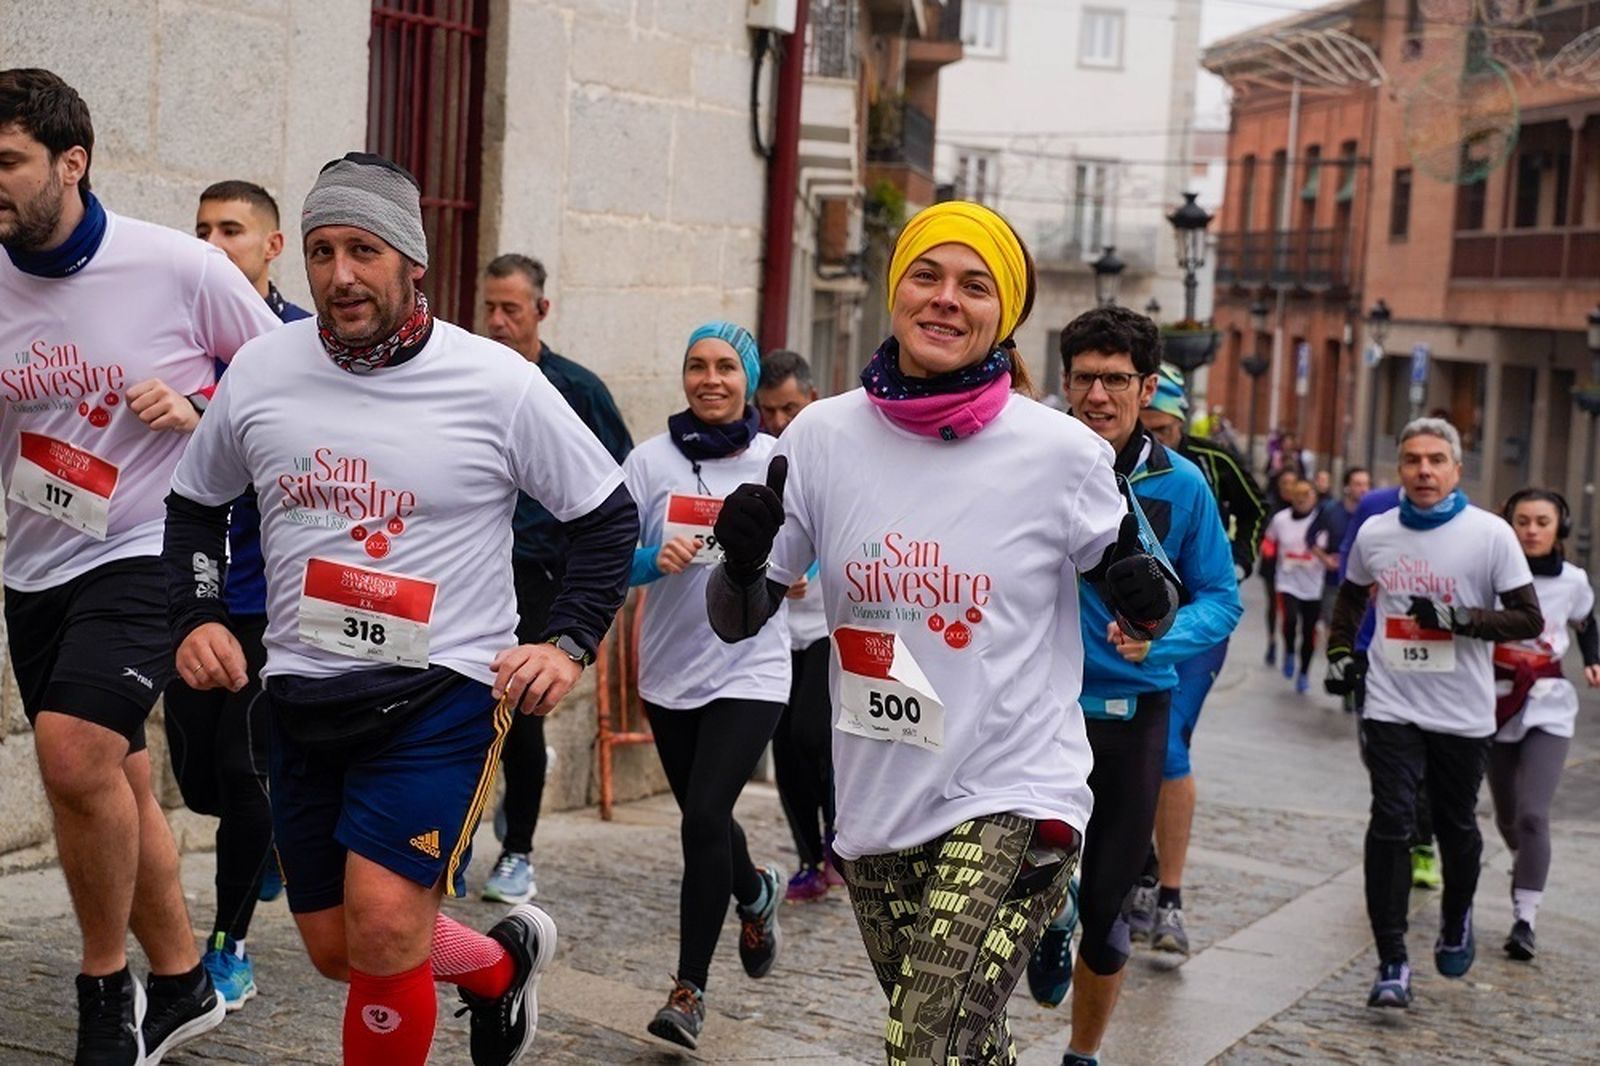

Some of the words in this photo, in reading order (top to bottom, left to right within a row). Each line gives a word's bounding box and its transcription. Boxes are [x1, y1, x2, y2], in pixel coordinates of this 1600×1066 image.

[15, 351, 31, 365] VIII
[31, 340, 79, 370] San
[0, 361, 125, 402] Silvestre
[293, 457, 312, 472] VIII
[314, 447, 368, 484] San
[46, 483, 73, 508] 117
[278, 473, 416, 520] Silvestre
[862, 542, 881, 558] VIII
[883, 532, 940, 568] San
[845, 560, 991, 609] Silvestre
[343, 616, 387, 646] 318
[1403, 647, 1429, 661] 153
[869, 690, 921, 724] 500
[409, 837, 440, 859] adidas
